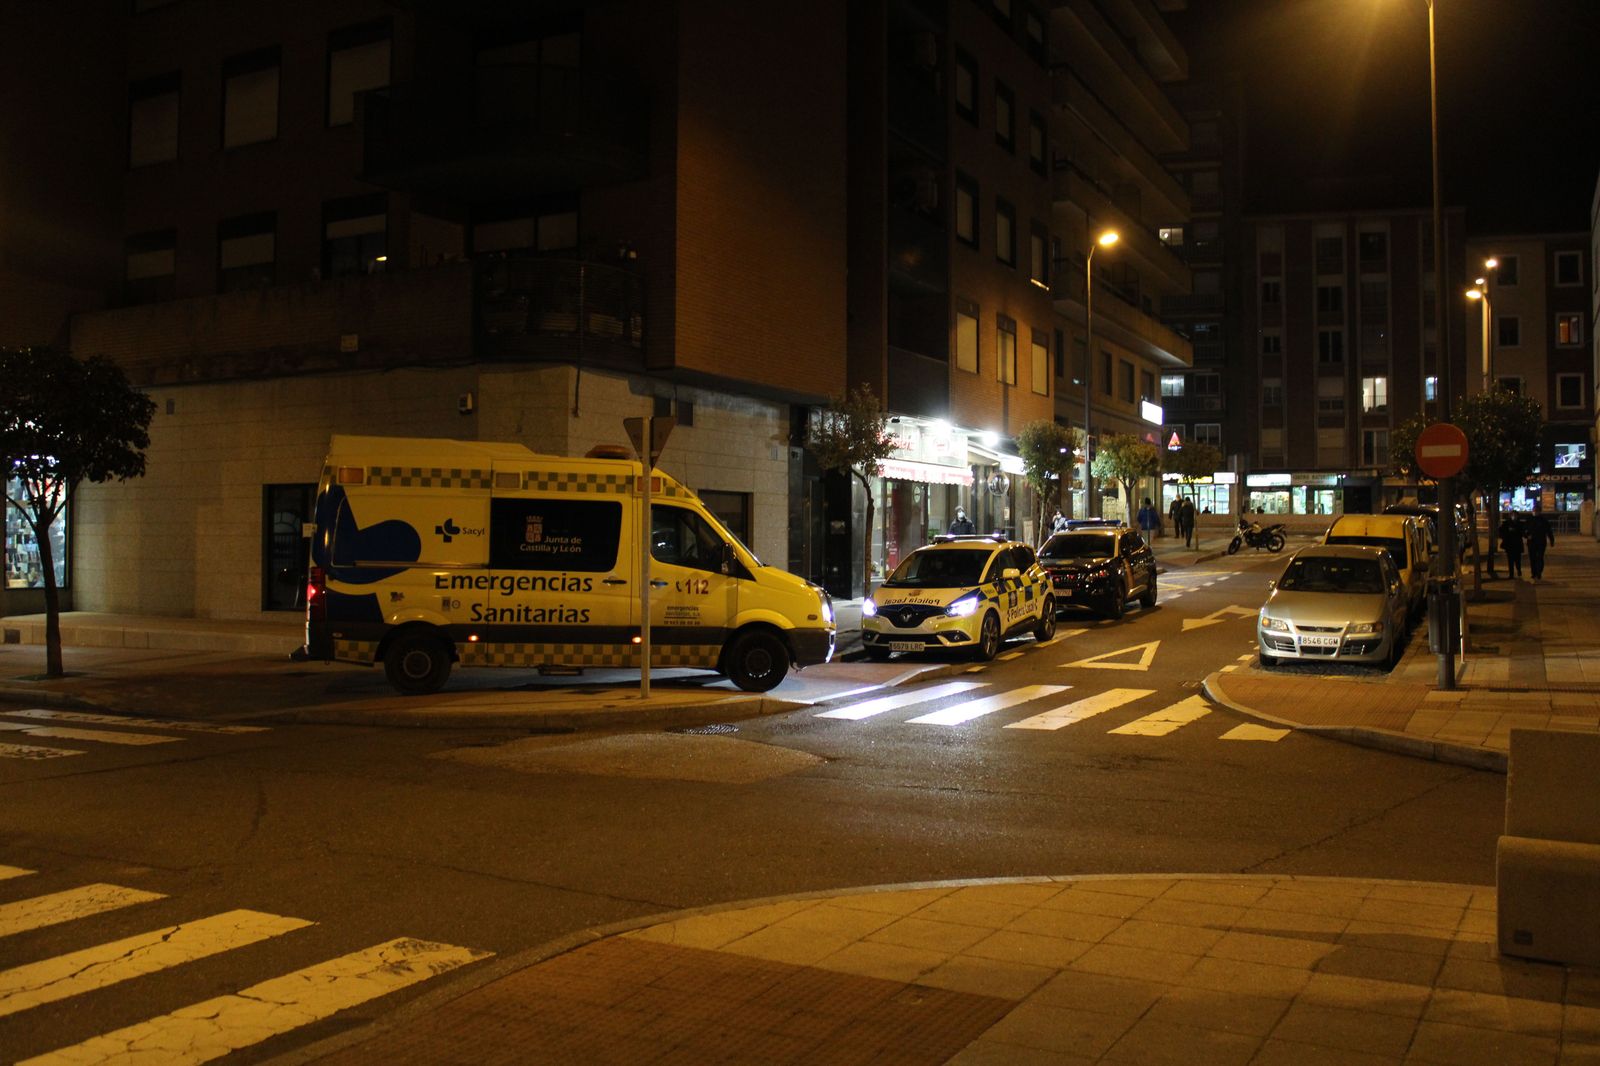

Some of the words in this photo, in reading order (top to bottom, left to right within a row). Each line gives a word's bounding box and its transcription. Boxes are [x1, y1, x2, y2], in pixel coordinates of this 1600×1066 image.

[462, 527, 485, 536] Sacyl
[544, 535, 569, 544] Junta
[572, 536, 582, 544] de
[519, 543, 551, 552] Castilla
[552, 545, 558, 554] y
[560, 543, 582, 553] León
[435, 573, 593, 596] Emergencias
[686, 579, 709, 595] 112
[470, 603, 591, 623] Sanitarias
[1302, 637, 1322, 645] 8546
